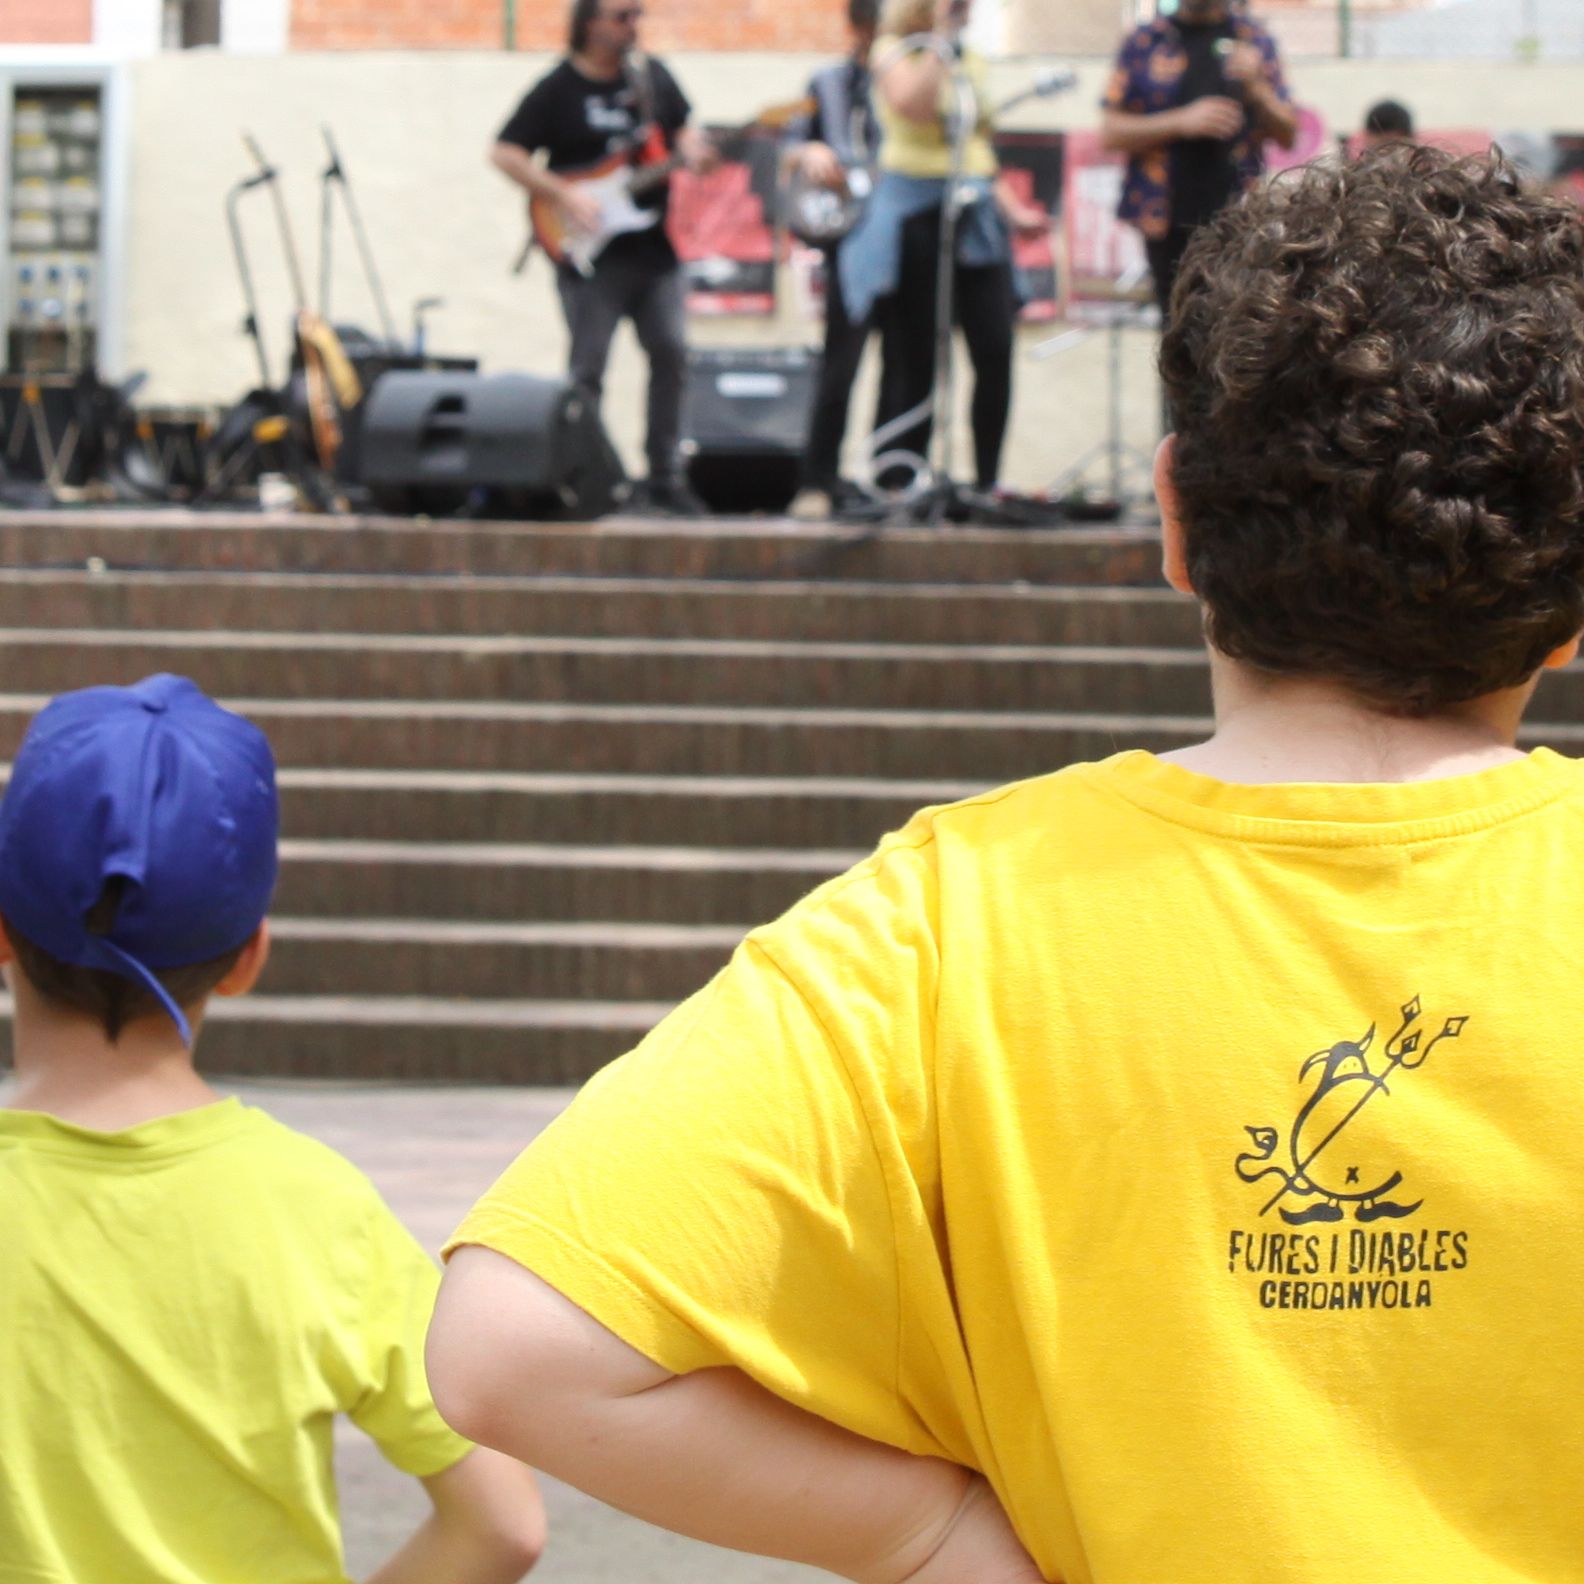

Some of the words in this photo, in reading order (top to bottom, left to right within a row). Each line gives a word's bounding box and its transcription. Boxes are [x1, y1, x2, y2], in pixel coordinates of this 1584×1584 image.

[1228, 1230, 1321, 1275] FURES
[1329, 1233, 1339, 1273] I
[1347, 1228, 1468, 1276] DIABLES
[1259, 1279, 1432, 1310] CERDANYOLA
